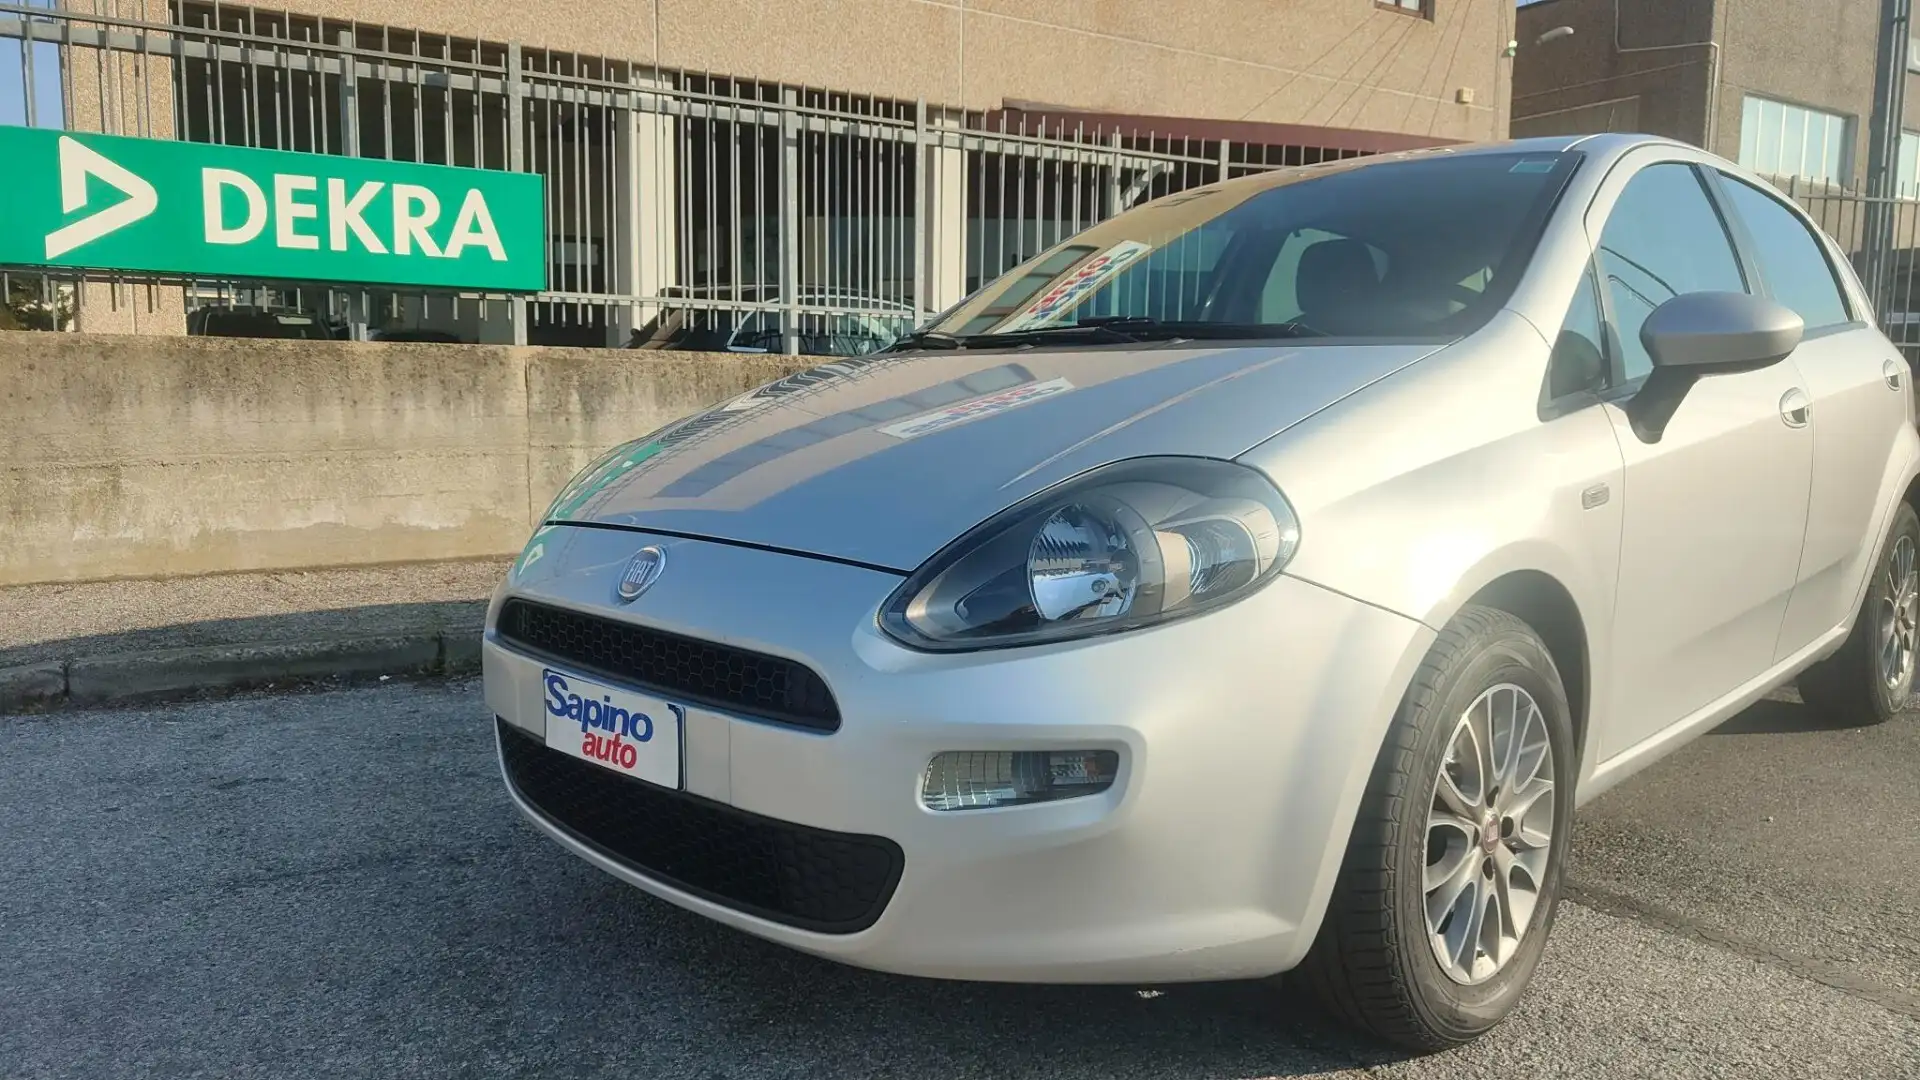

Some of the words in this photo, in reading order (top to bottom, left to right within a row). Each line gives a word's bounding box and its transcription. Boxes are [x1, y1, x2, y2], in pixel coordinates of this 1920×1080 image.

[202, 167, 508, 261] DEKRA
[624, 559, 656, 585] FIAT
[547, 674, 654, 743] Sapino
[582, 732, 637, 769] auto
